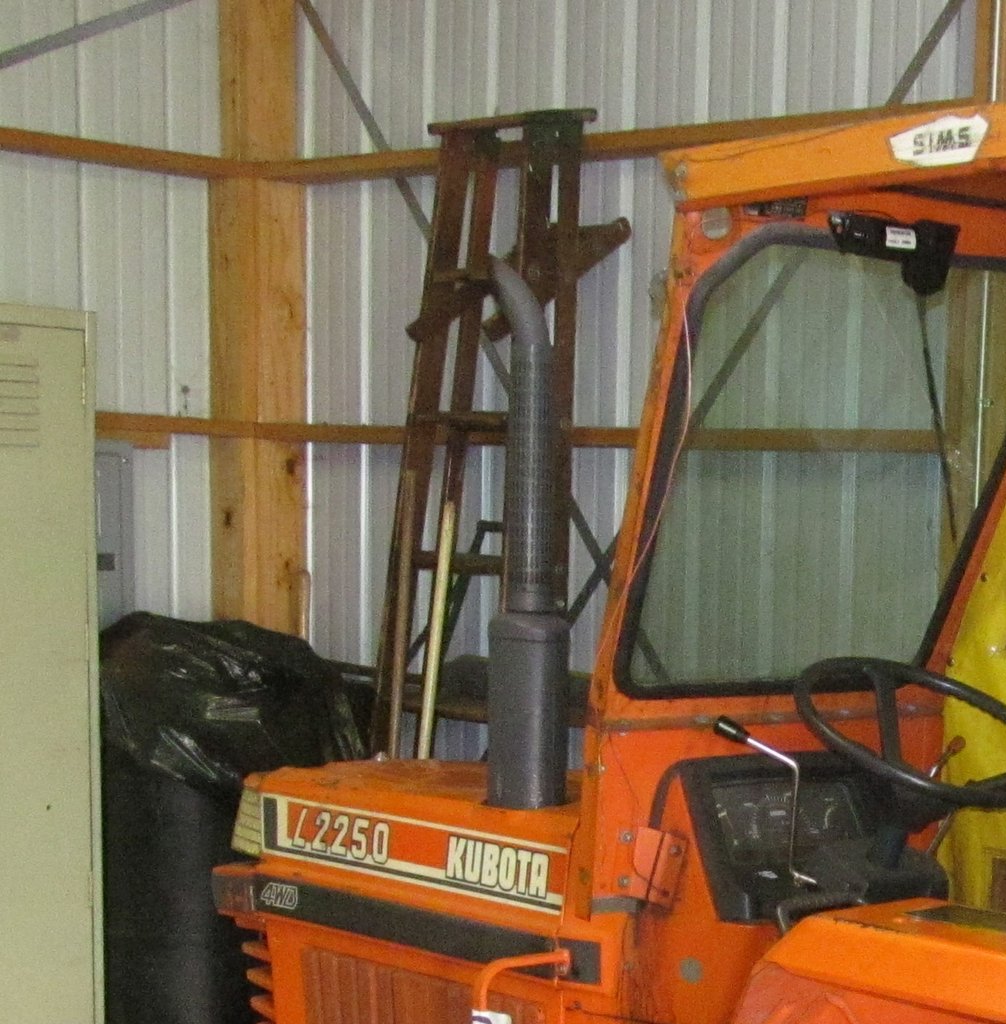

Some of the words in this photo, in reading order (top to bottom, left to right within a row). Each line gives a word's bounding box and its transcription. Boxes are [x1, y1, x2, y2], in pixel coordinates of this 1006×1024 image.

[913, 127, 972, 156] SIMS
[291, 807, 391, 865] L2250
[445, 834, 551, 899] KUBOTA
[260, 882, 298, 910] 4WD
